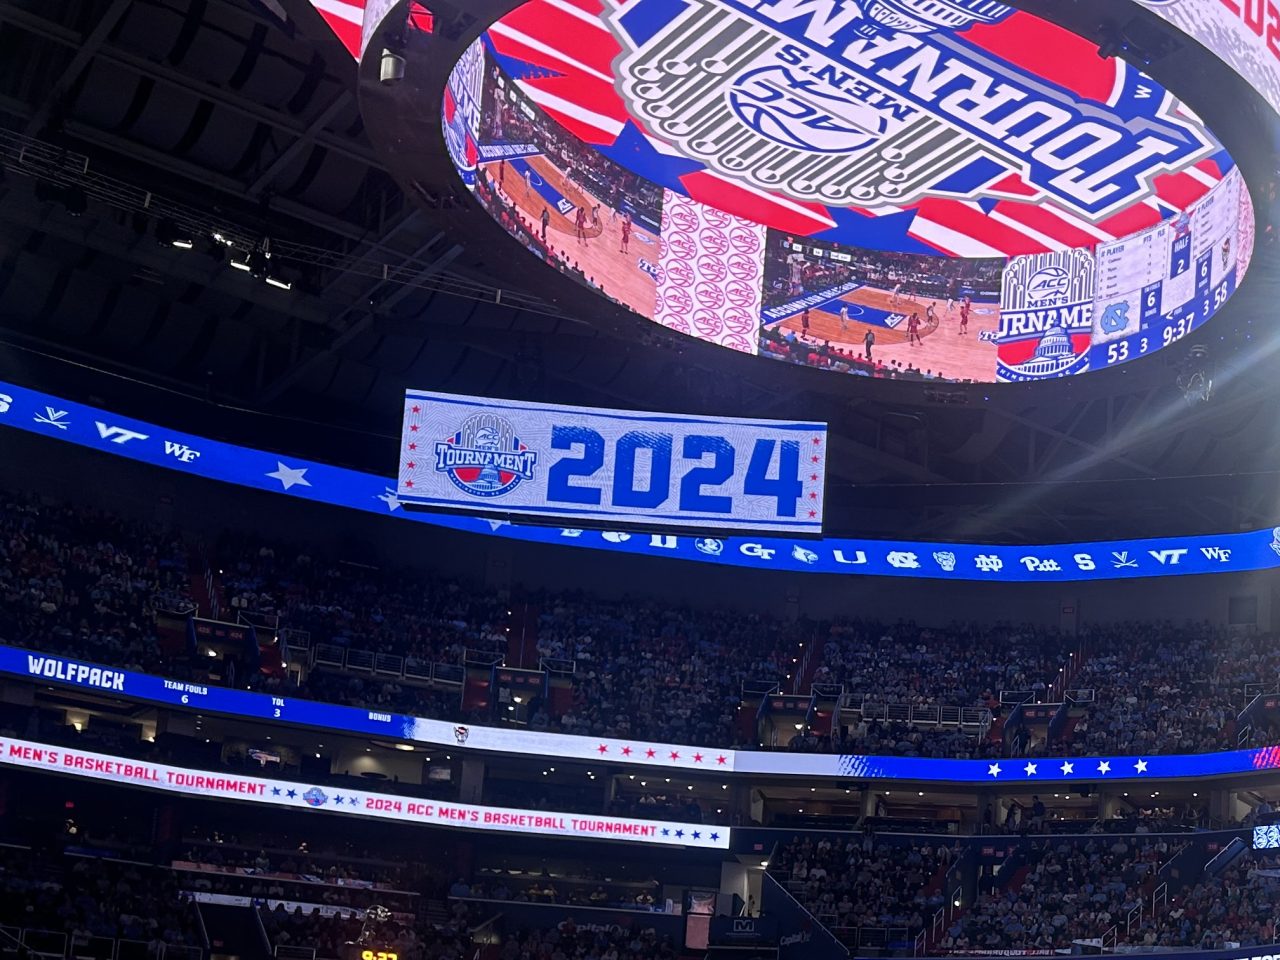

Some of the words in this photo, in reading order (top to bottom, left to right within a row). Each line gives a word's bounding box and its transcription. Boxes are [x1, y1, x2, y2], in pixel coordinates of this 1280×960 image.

[775, 44, 918, 123] MEN'S
[1174, 236, 1190, 254] HALF
[1176, 259, 1185, 275] 2
[1200, 261, 1208, 277] 6
[1032, 277, 1068, 289] ACC
[1026, 296, 1069, 309] MEN'S
[1147, 292, 1156, 307] 6
[1214, 280, 1229, 311] 58
[1203, 299, 1210, 316] 3
[1163, 312, 1195, 347] 9:37
[1107, 341, 1129, 363] 53
[1140, 338, 1148, 353] 3
[95, 421, 150, 444] VT
[164, 440, 201, 464] WF
[437, 444, 535, 478] TOURNAMENT
[546, 423, 804, 517] 2024
[1020, 556, 1061, 573] Pitt
[1147, 548, 1189, 565] VT
[1200, 547, 1232, 564] WF
[28, 655, 125, 691] WOLFPACK
[164, 680, 184, 693] TEAM
[185, 683, 208, 696] FOULS
[181, 694, 189, 704] 6
[272, 697, 285, 708] TOL
[273, 708, 281, 718] 3
[368, 711, 392, 723] BONUS
[9, 743, 58, 764] MEN'S
[64, 753, 160, 782] BASKETBALL
[166, 771, 267, 796] TOURNAMENT
[365, 797, 402, 814] 2024
[407, 803, 434, 818] ACC
[438, 805, 479, 822] MEN'S
[484, 811, 566, 830] BASKETBALL
[571, 818, 657, 837] TOURNAMENT
